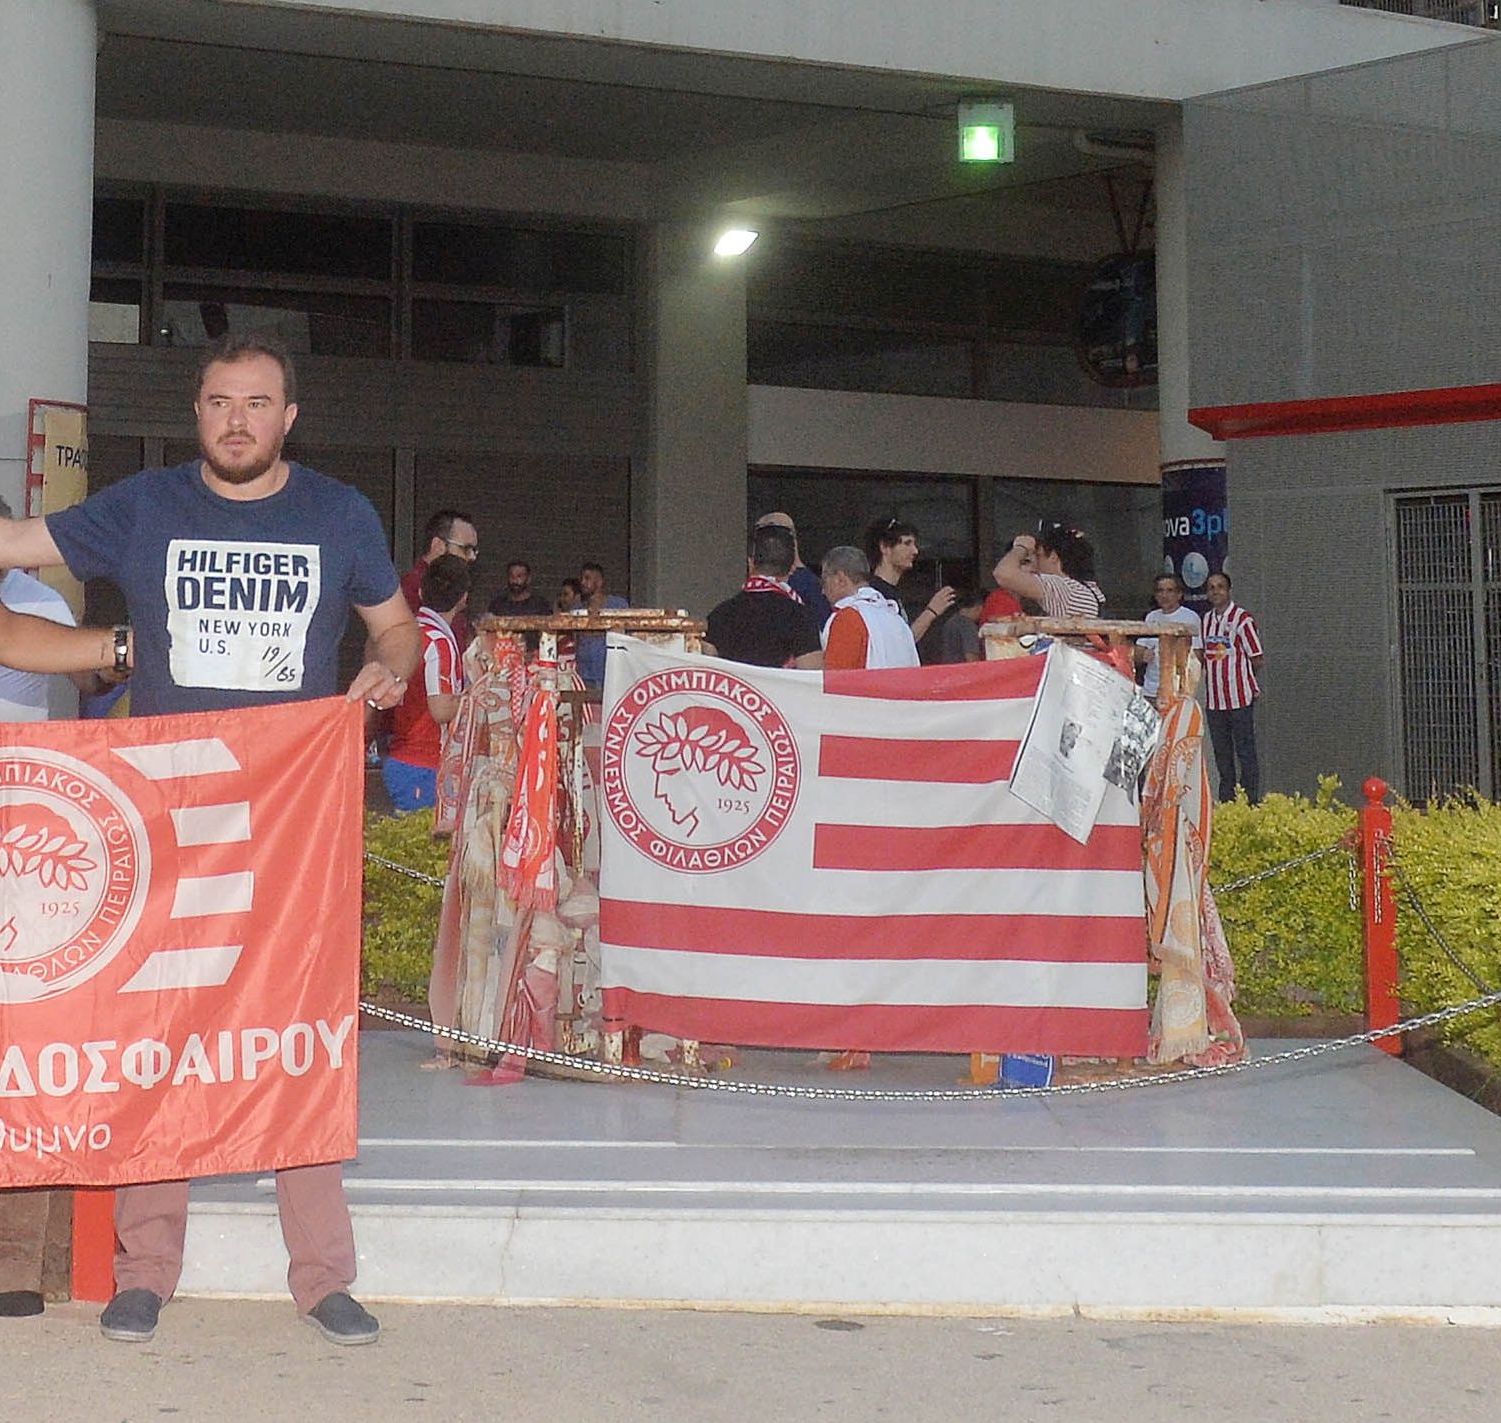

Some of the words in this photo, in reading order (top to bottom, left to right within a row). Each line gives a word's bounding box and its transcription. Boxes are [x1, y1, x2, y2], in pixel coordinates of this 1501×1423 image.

[177, 549, 309, 577] HILFIGER
[177, 576, 309, 613] DENIM
[199, 619, 241, 635] NEW
[248, 622, 291, 637] YORK
[199, 639, 231, 655] U.S.
[633, 672, 772, 721] ΟΛΥΜΠΙΑΚΟΣ
[604, 708, 647, 842] ΣΥΝΔΕΣΜΟΣ
[765, 725, 796, 826] ΠΕΙΡΑΙΩΣ
[718, 798, 750, 814] 1925
[650, 828, 768, 869] ΦΙΛΑΘΛΩΝ
[99, 811, 132, 926] ΠΕΙΡΑΙΩΣ
[41, 902, 80, 919] 1925
